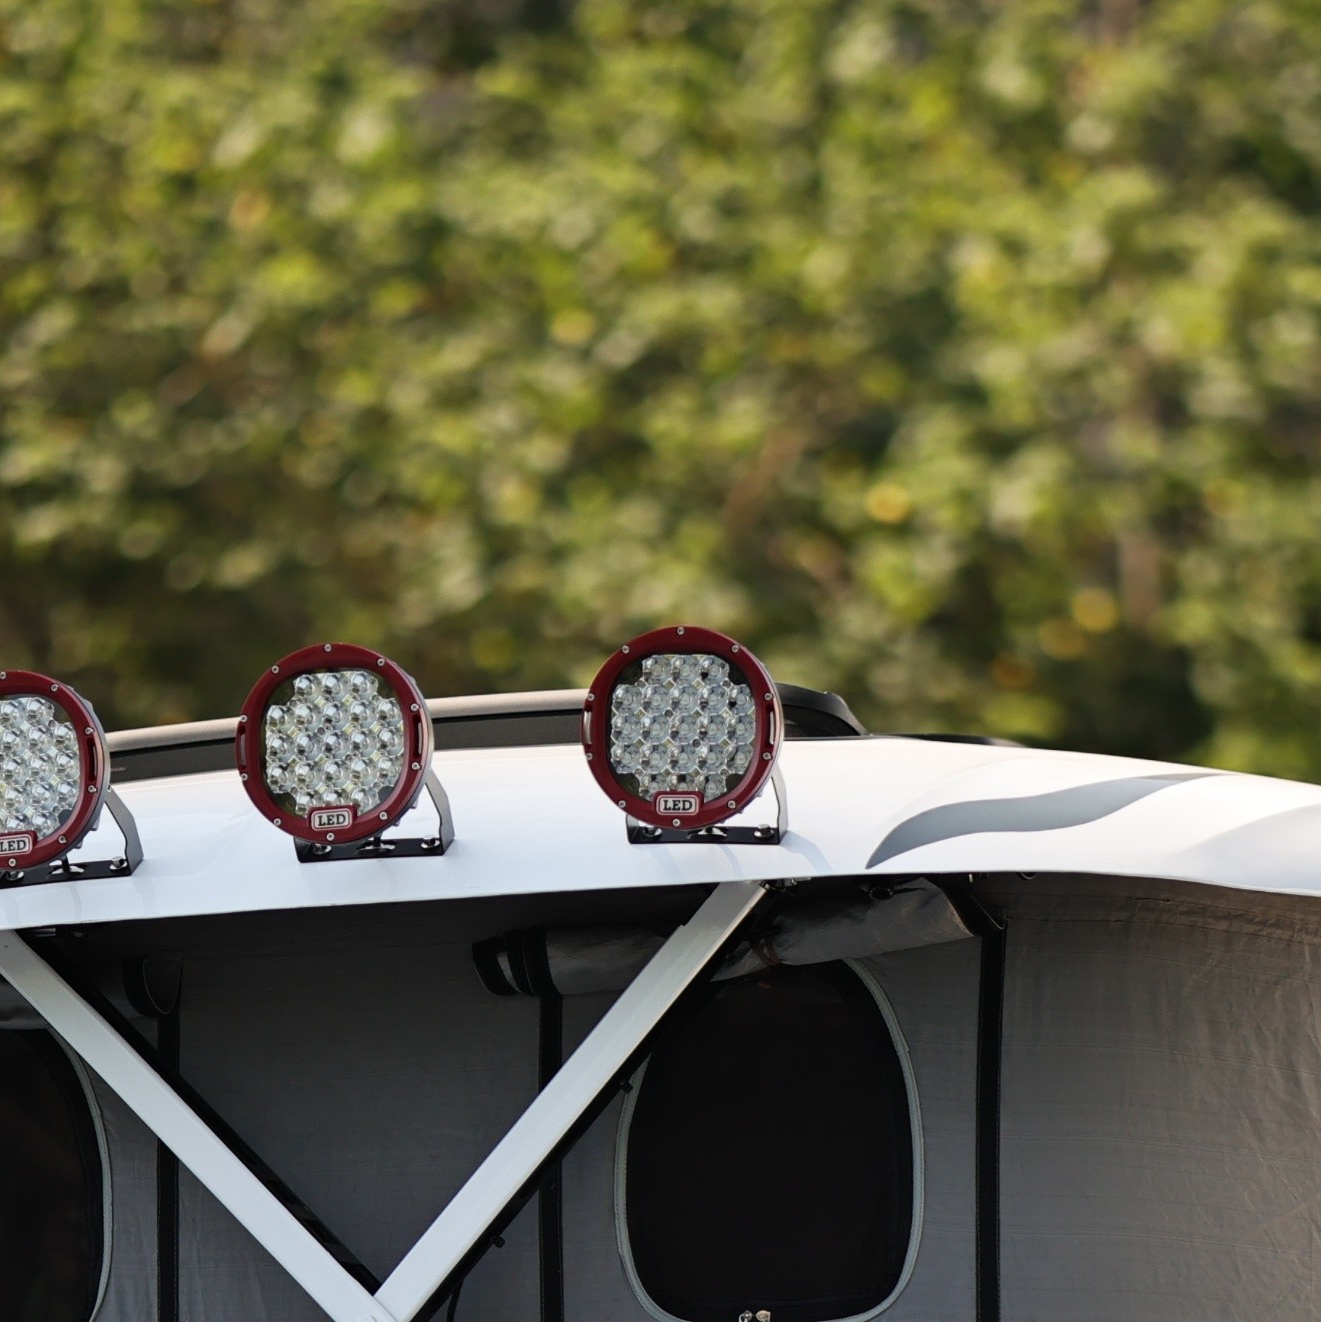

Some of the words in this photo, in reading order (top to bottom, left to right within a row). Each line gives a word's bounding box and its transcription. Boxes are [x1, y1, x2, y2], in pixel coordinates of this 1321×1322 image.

[663, 799, 692, 811] LED
[318, 813, 346, 826] LED
[0, 840, 26, 852] LED
